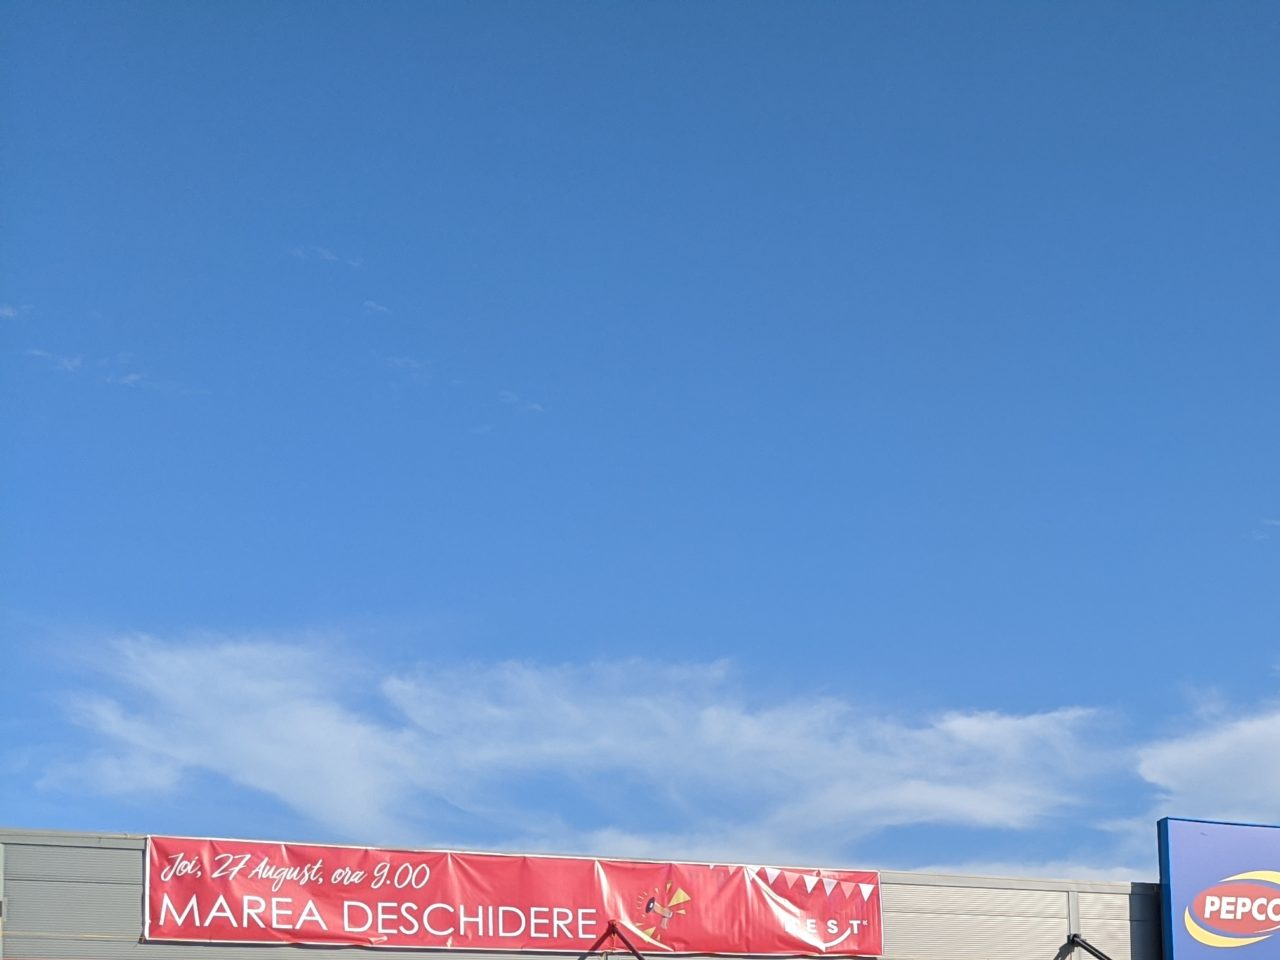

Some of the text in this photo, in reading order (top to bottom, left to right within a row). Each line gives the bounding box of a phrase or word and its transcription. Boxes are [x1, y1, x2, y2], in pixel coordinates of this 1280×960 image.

[161, 853, 431, 892] Joi, 27 August, ora 9.00
[159, 893, 597, 938] MAREA DESCHIDERE
[784, 918, 861, 935] EST
